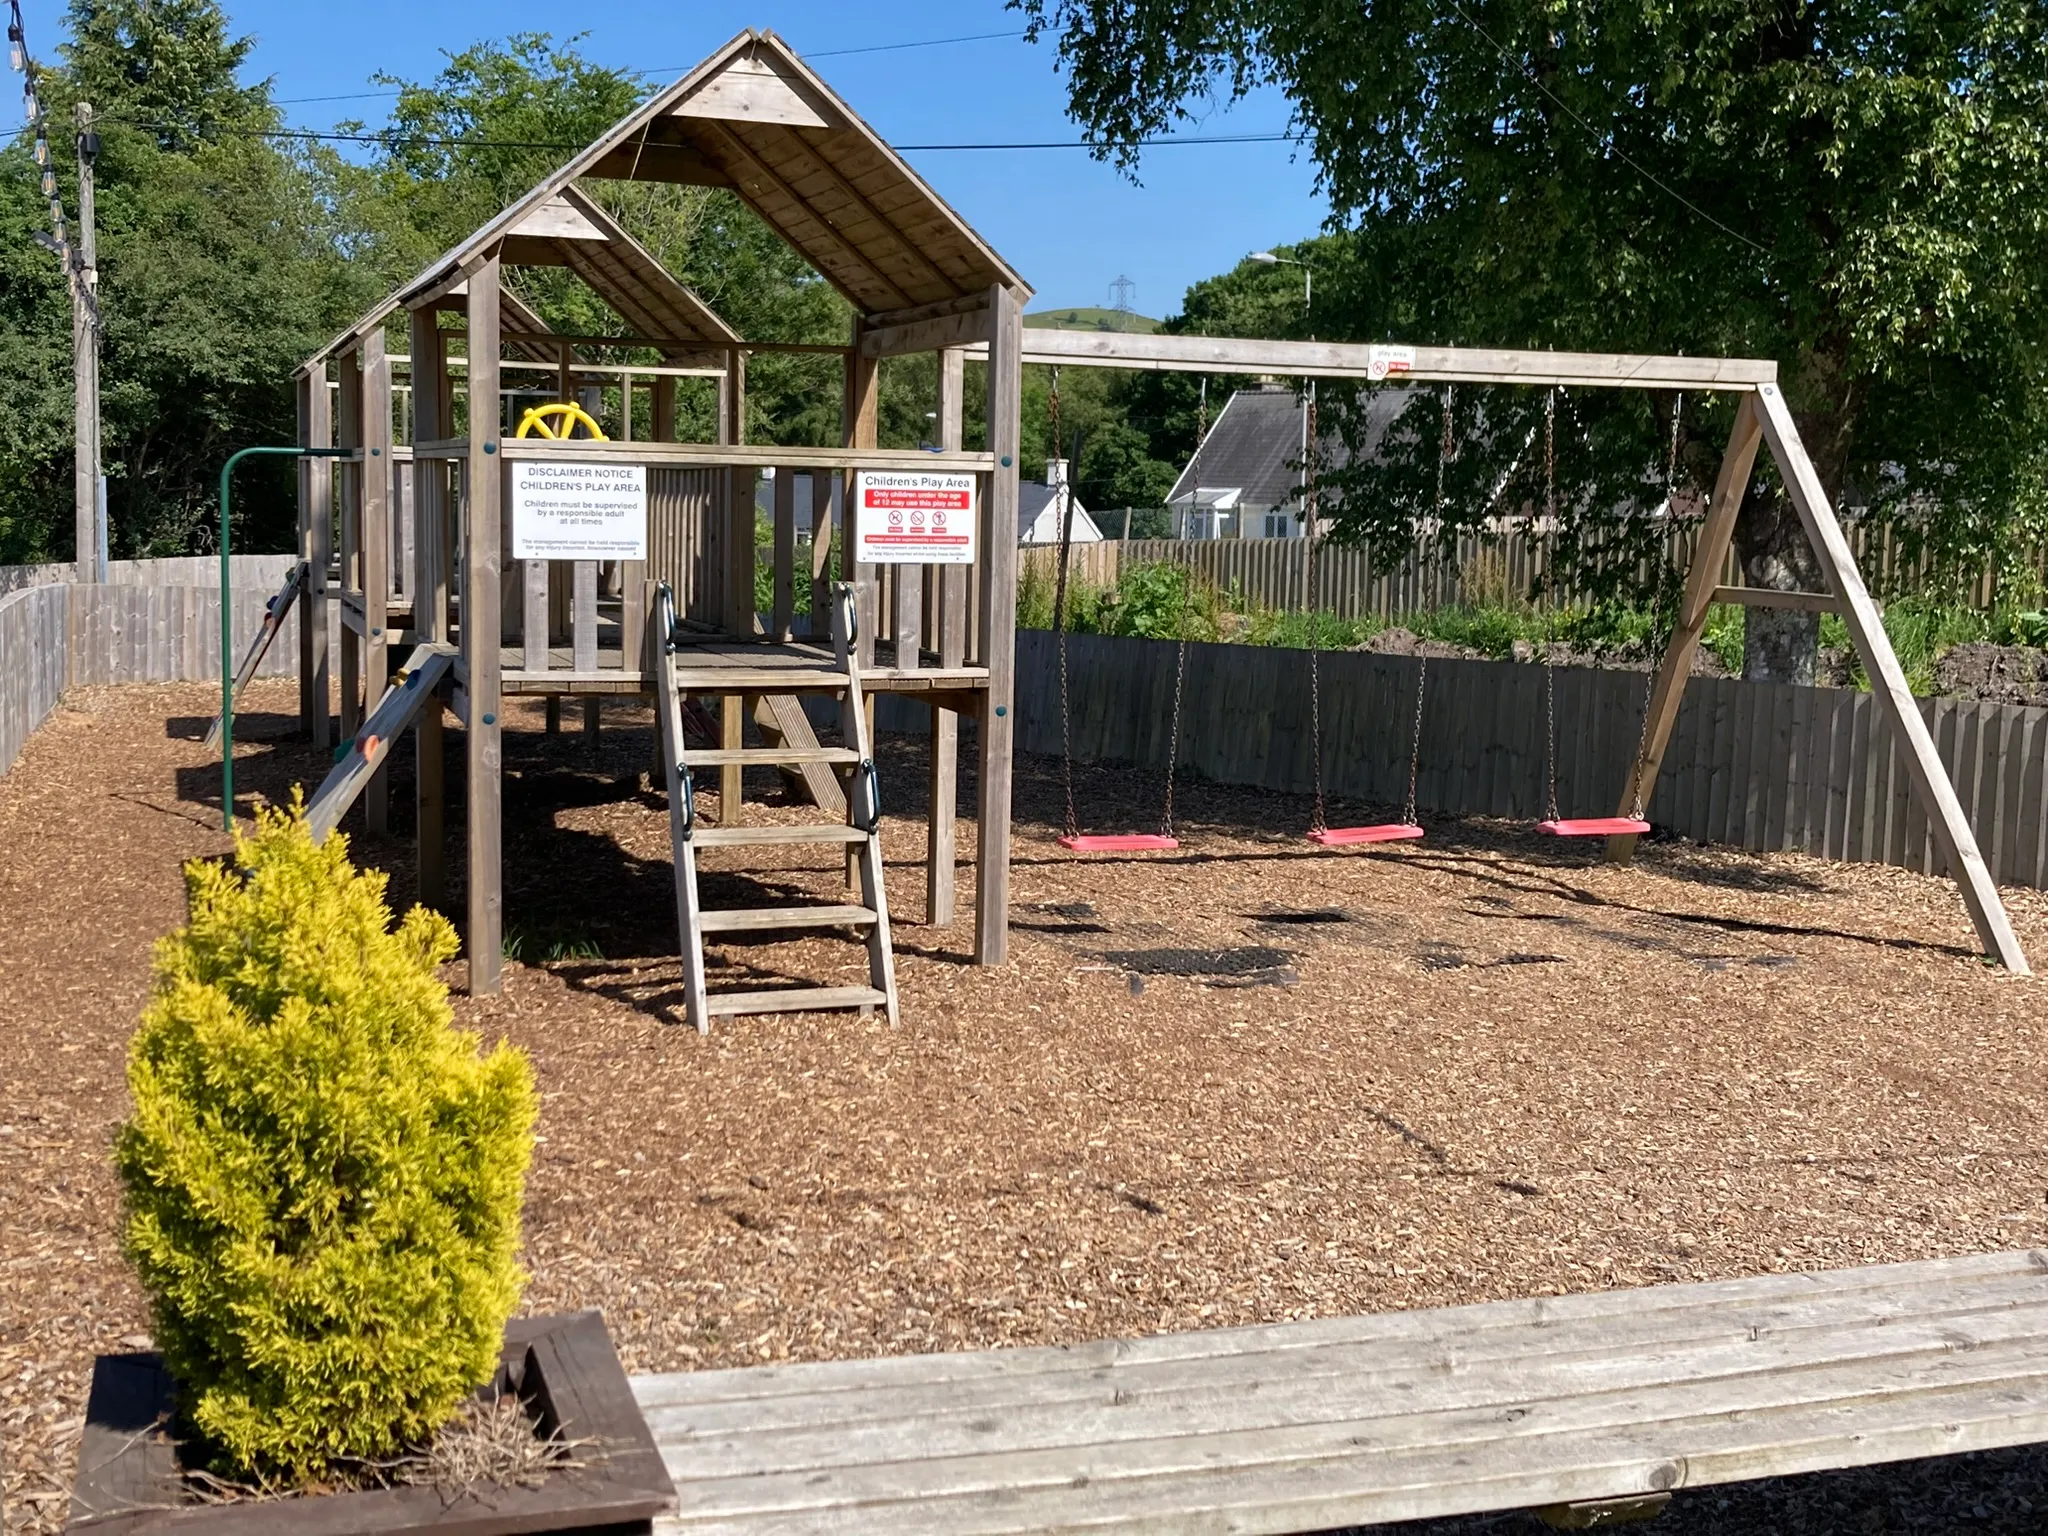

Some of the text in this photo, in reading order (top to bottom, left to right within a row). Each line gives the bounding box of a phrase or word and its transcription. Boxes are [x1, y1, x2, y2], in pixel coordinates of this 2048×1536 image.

[528, 467, 633, 478] DISCLAIMER NOTICE
[520, 481, 640, 492] CHILDREN'S PLAY AREA
[865, 476, 970, 489] Children's Play Area
[873, 490, 889, 498] Only
[524, 500, 558, 508] Children
[538, 509, 548, 517] by
[557, 510, 602, 518] responsible
